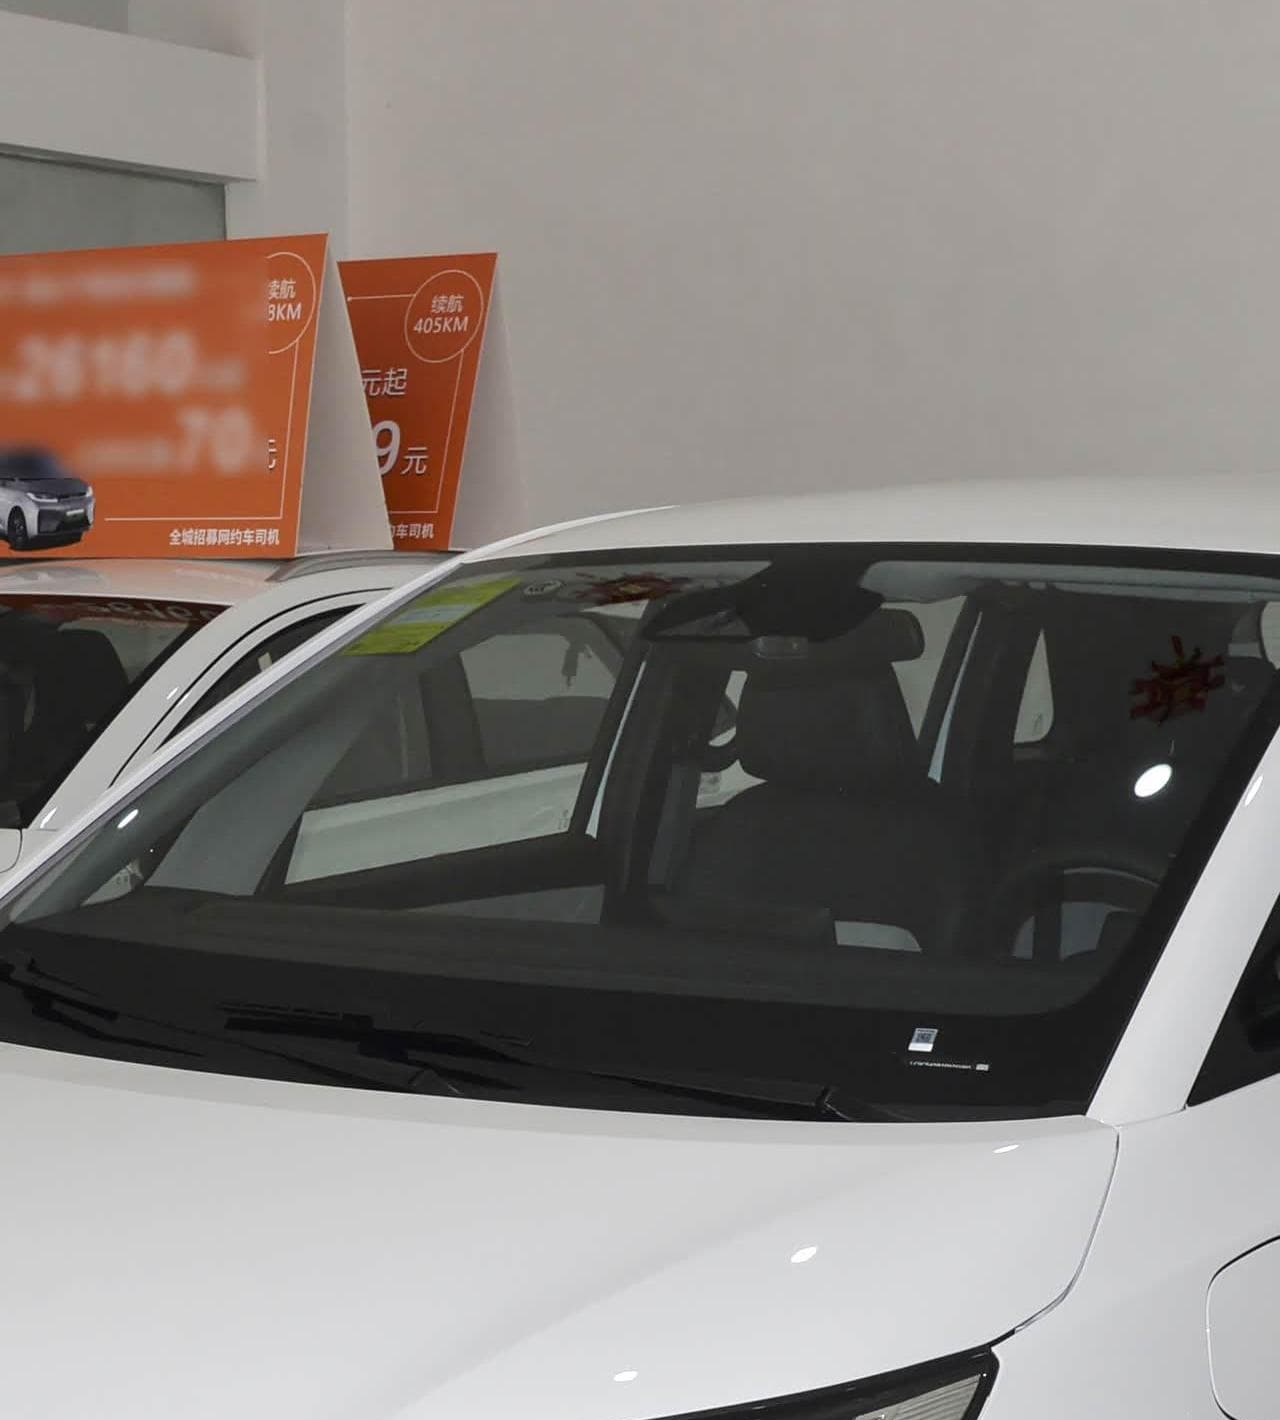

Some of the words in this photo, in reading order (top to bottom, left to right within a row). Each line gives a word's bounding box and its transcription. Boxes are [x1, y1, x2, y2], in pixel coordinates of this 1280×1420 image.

[431, 294, 464, 313] 续航
[413, 316, 468, 334] 405KM
[169, 528, 280, 546] 全城招募网约车司机
[391, 523, 435, 539] 车司机
